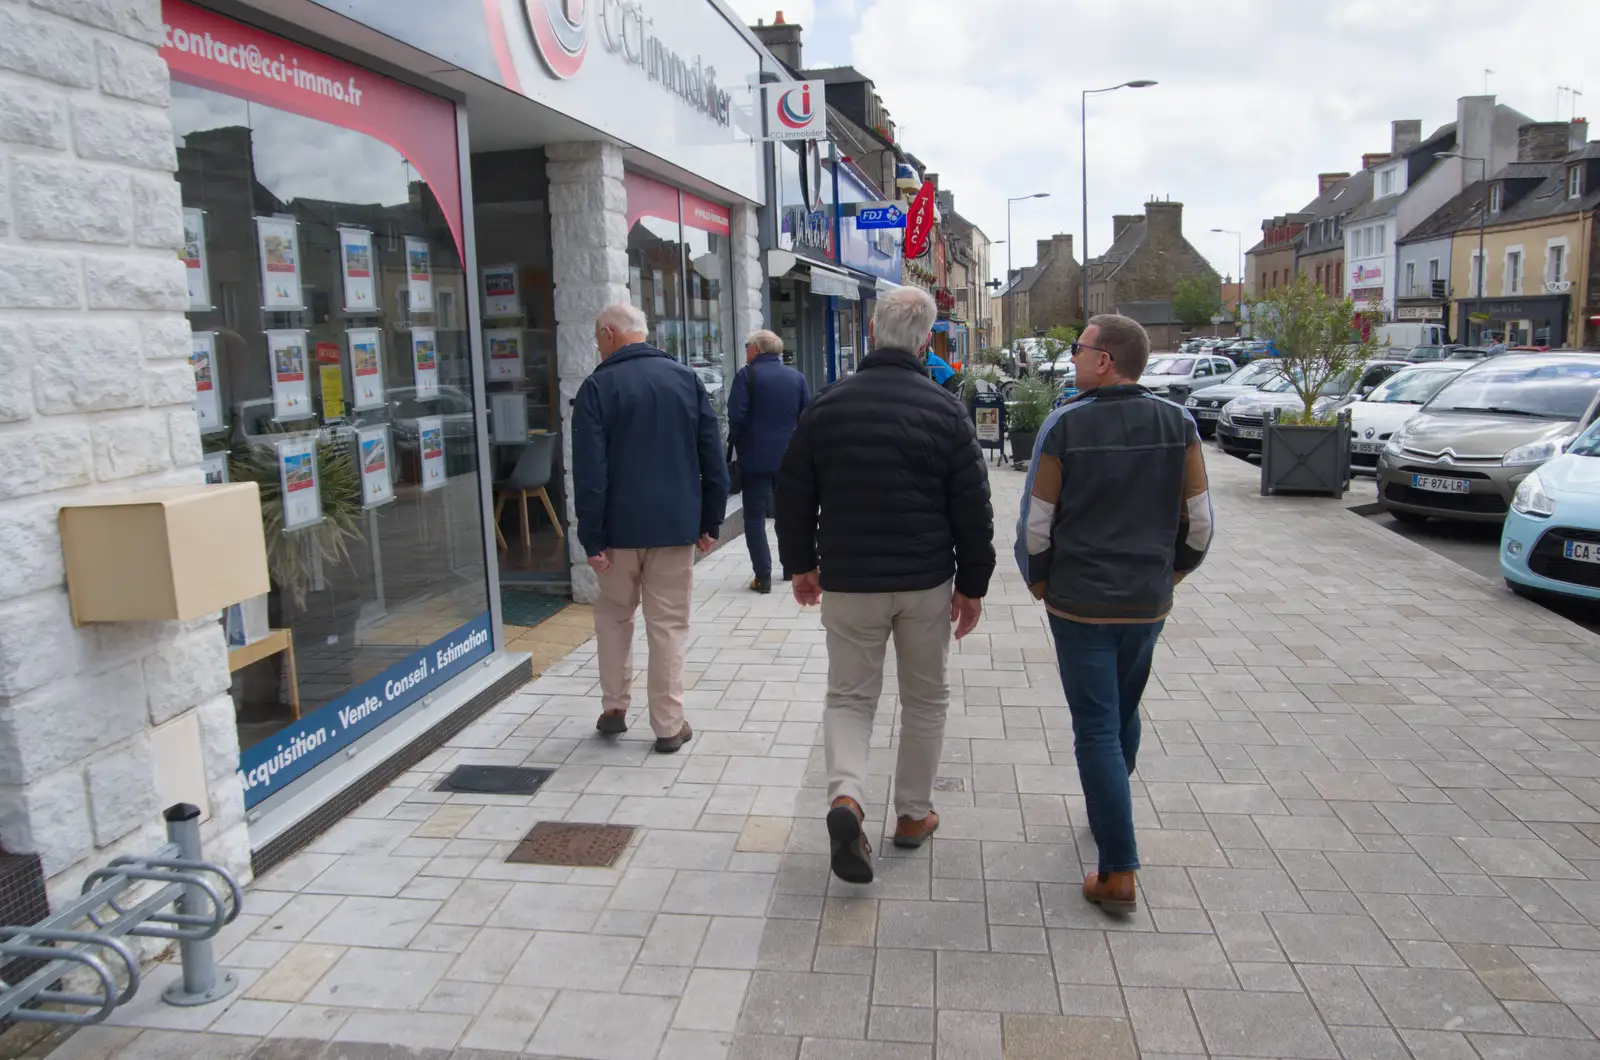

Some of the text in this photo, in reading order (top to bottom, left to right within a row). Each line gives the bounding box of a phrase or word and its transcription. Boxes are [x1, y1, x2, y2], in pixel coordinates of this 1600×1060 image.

[160, 23, 363, 106] contact@cci-immo.fr
[862, 210, 883, 220] FDJ
[911, 196, 929, 244] TABAC
[236, 727, 327, 792] Acquisition
[385, 661, 428, 701] Conseil
[437, 628, 488, 670] Estimation
